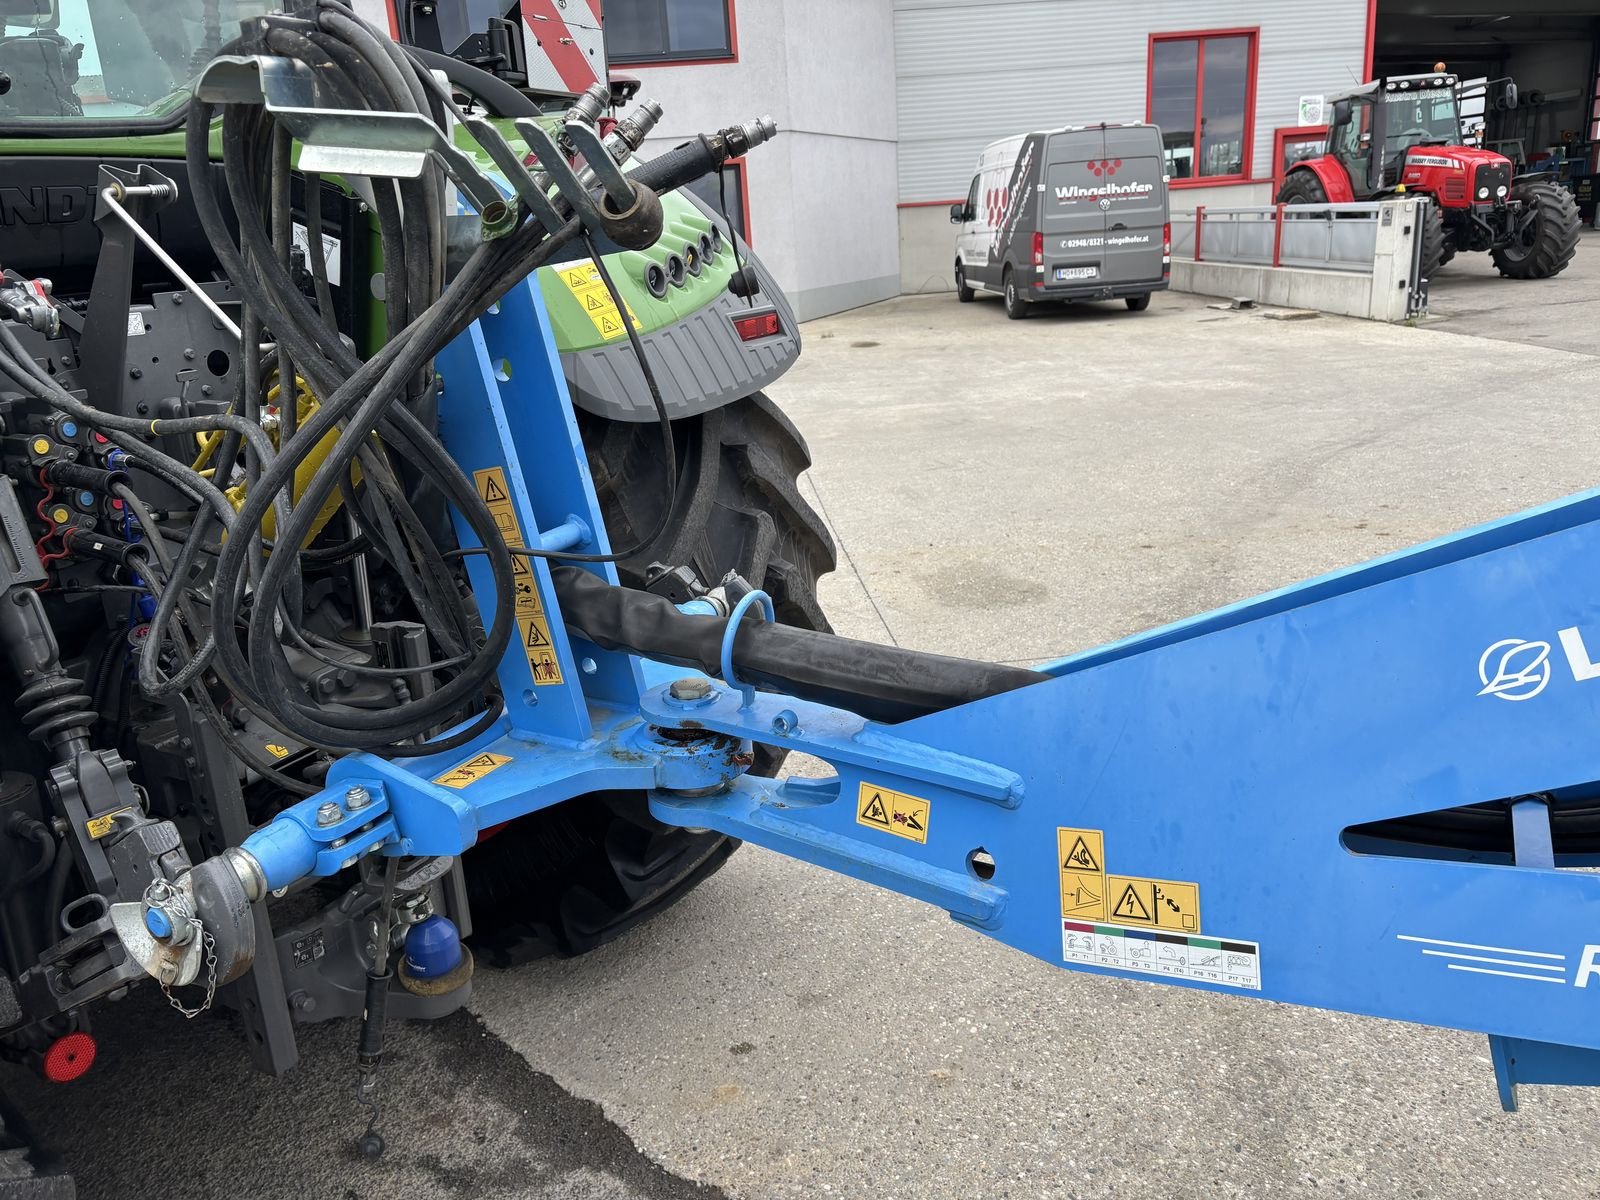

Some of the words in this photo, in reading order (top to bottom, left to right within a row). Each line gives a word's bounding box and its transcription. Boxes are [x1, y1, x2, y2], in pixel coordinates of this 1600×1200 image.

[1055, 181, 1153, 203] Wingelhofer
[1067, 237, 1104, 249] 02948/8321
[1107, 235, 1149, 247] wingelhofer.at
[1173, 966, 1184, 974] (T4)
